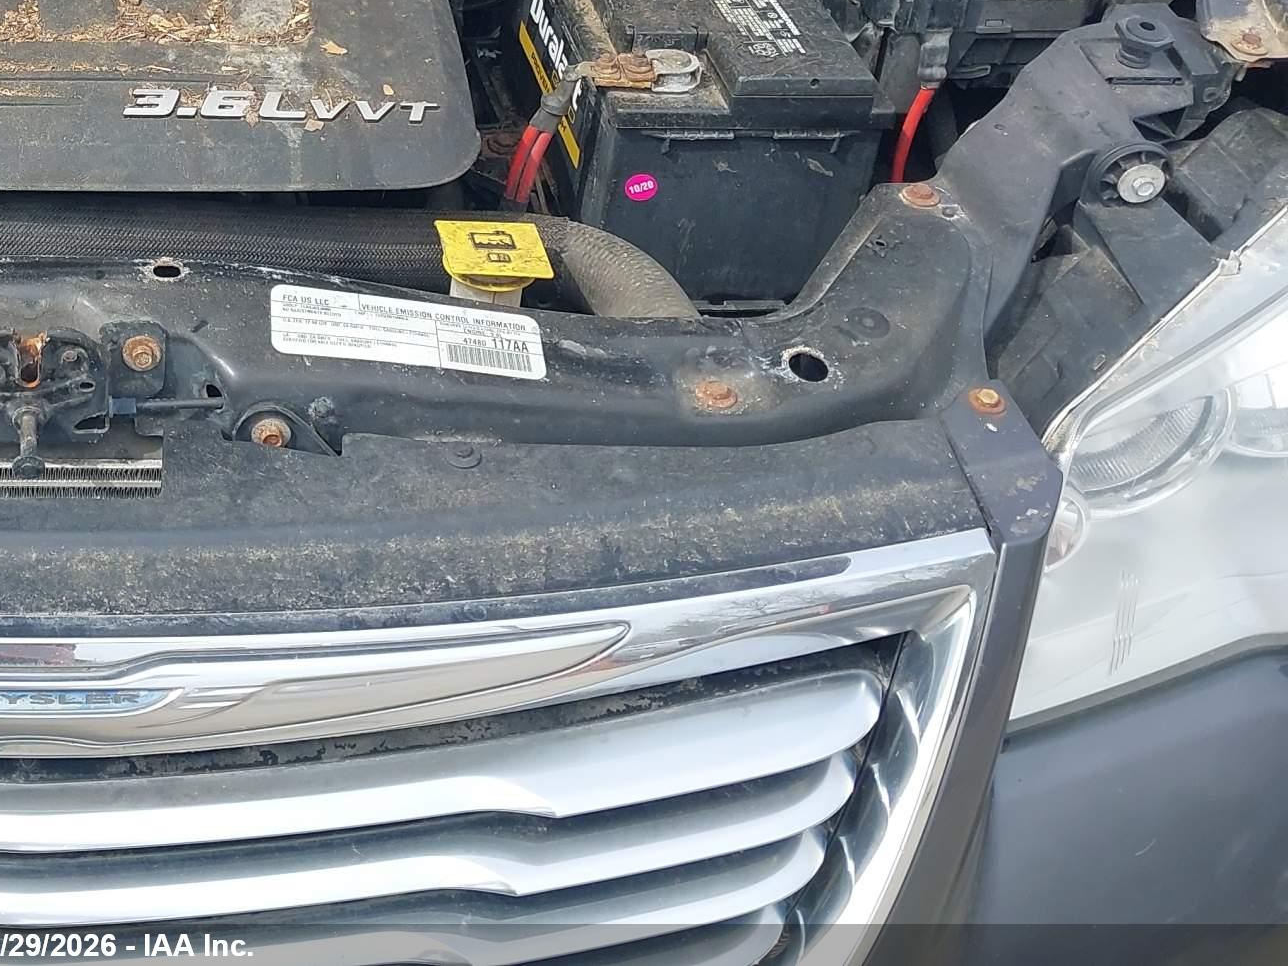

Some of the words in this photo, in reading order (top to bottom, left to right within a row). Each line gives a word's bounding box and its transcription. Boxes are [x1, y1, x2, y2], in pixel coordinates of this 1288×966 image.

[628, 180, 655, 196] 10/20
[282, 294, 298, 303] FCA
[300, 296, 312, 304] US
[314, 297, 330, 306] LLC
[361, 303, 393, 315] VEHICLE
[395, 307, 432, 320] EMISSION
[435, 313, 470, 324] CONTROL
[472, 317, 526, 331] INFORMATION
[492, 336, 529, 353] 117AA
